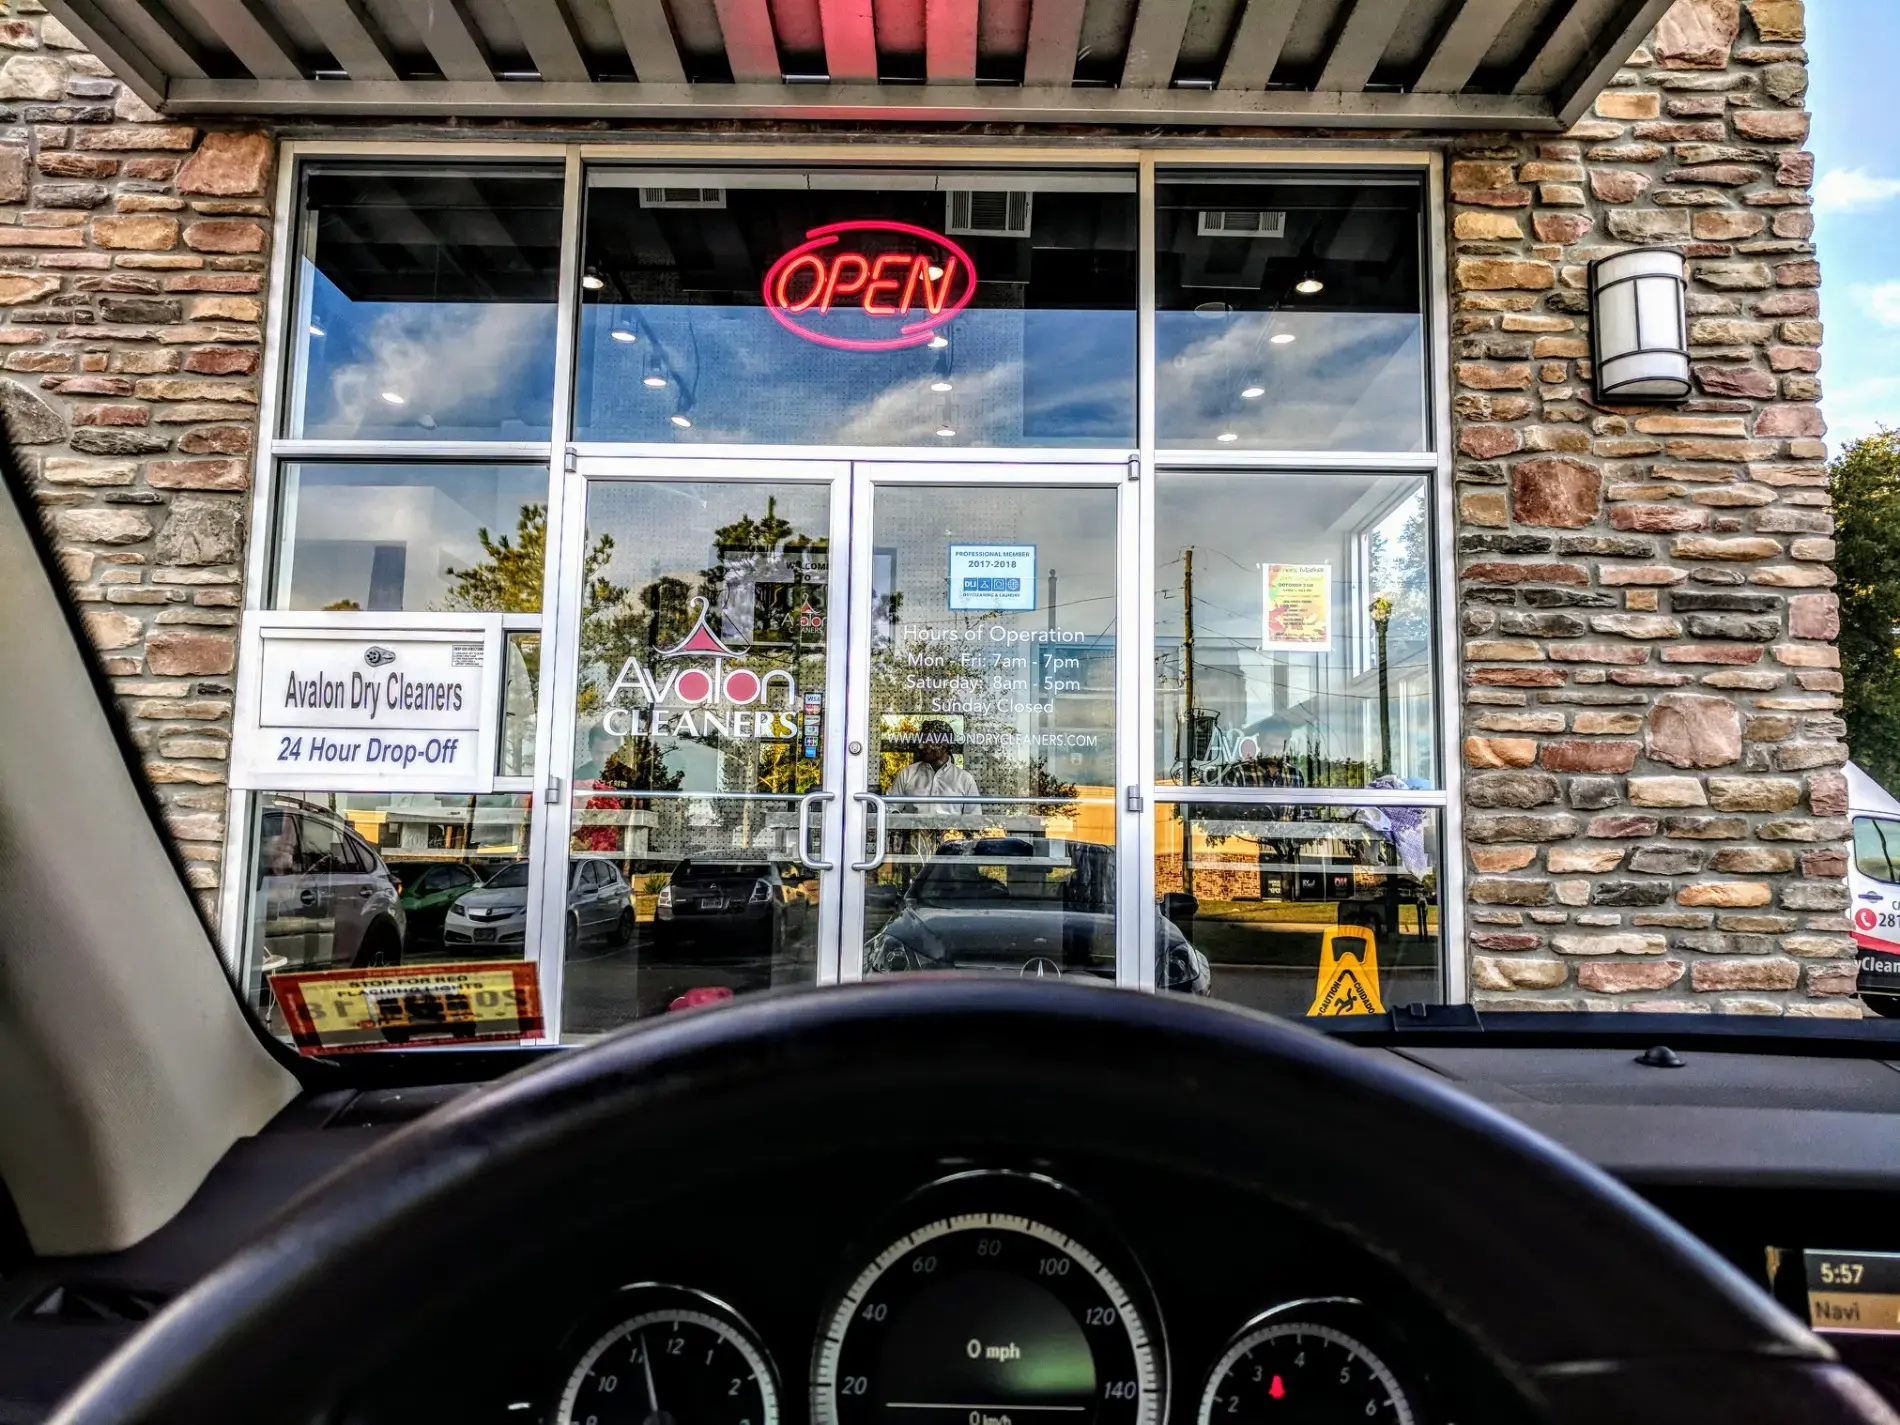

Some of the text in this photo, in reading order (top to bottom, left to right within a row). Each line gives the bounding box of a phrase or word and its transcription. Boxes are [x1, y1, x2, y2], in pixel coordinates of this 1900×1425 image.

[776, 254, 957, 316] OPEN
[968, 560, 1017, 568] 2017-2018
[904, 625, 1085, 647] Hours of Operation
[908, 652, 944, 668] Mon
[993, 653, 1027, 668] 7am
[1043, 653, 1080, 672] 7pm
[605, 656, 796, 705] Avalon
[906, 674, 983, 692] Saturday:
[993, 676, 1027, 690] 8am
[1044, 676, 1081, 695] 5pm
[284, 670, 462, 719] Avalon Dry Cleaners
[932, 698, 1054, 717] Sunday Closed
[603, 709, 798, 739] CLEANERS
[887, 731, 1098, 747] WWW.AVALONDRYCLEANERS.COM
[277, 737, 460, 769] 24 Hour Drop-Off
[349, 980, 392, 988] STOP
[1319, 979, 1342, 1014] CAUTION
[1354, 980, 1377, 1014] CUIDADO
[977, 1239, 1002, 1256] 80
[912, 1256, 937, 1273] 60
[1039, 1258, 1070, 1276] 100
[1821, 1262, 1864, 1284] 5:57
[862, 1303, 887, 1322] 40
[1085, 1307, 1116, 1326] 120
[1815, 1301, 1860, 1321] Navi
[666, 1337, 685, 1355] 12
[967, 1339, 1020, 1362] 0 mph
[705, 1348, 714, 1366] 1
[1294, 1351, 1305, 1368] 4
[1252, 1365, 1263, 1382] 3
[1339, 1367, 1351, 1384] 5
[598, 1374, 618, 1393] 10
[727, 1377, 742, 1396] 2
[841, 1376, 868, 1395] 20
[1105, 1381, 1137, 1399] 140
[1228, 1395, 1240, 1413] 2
[1365, 1399, 1377, 1416] 6
